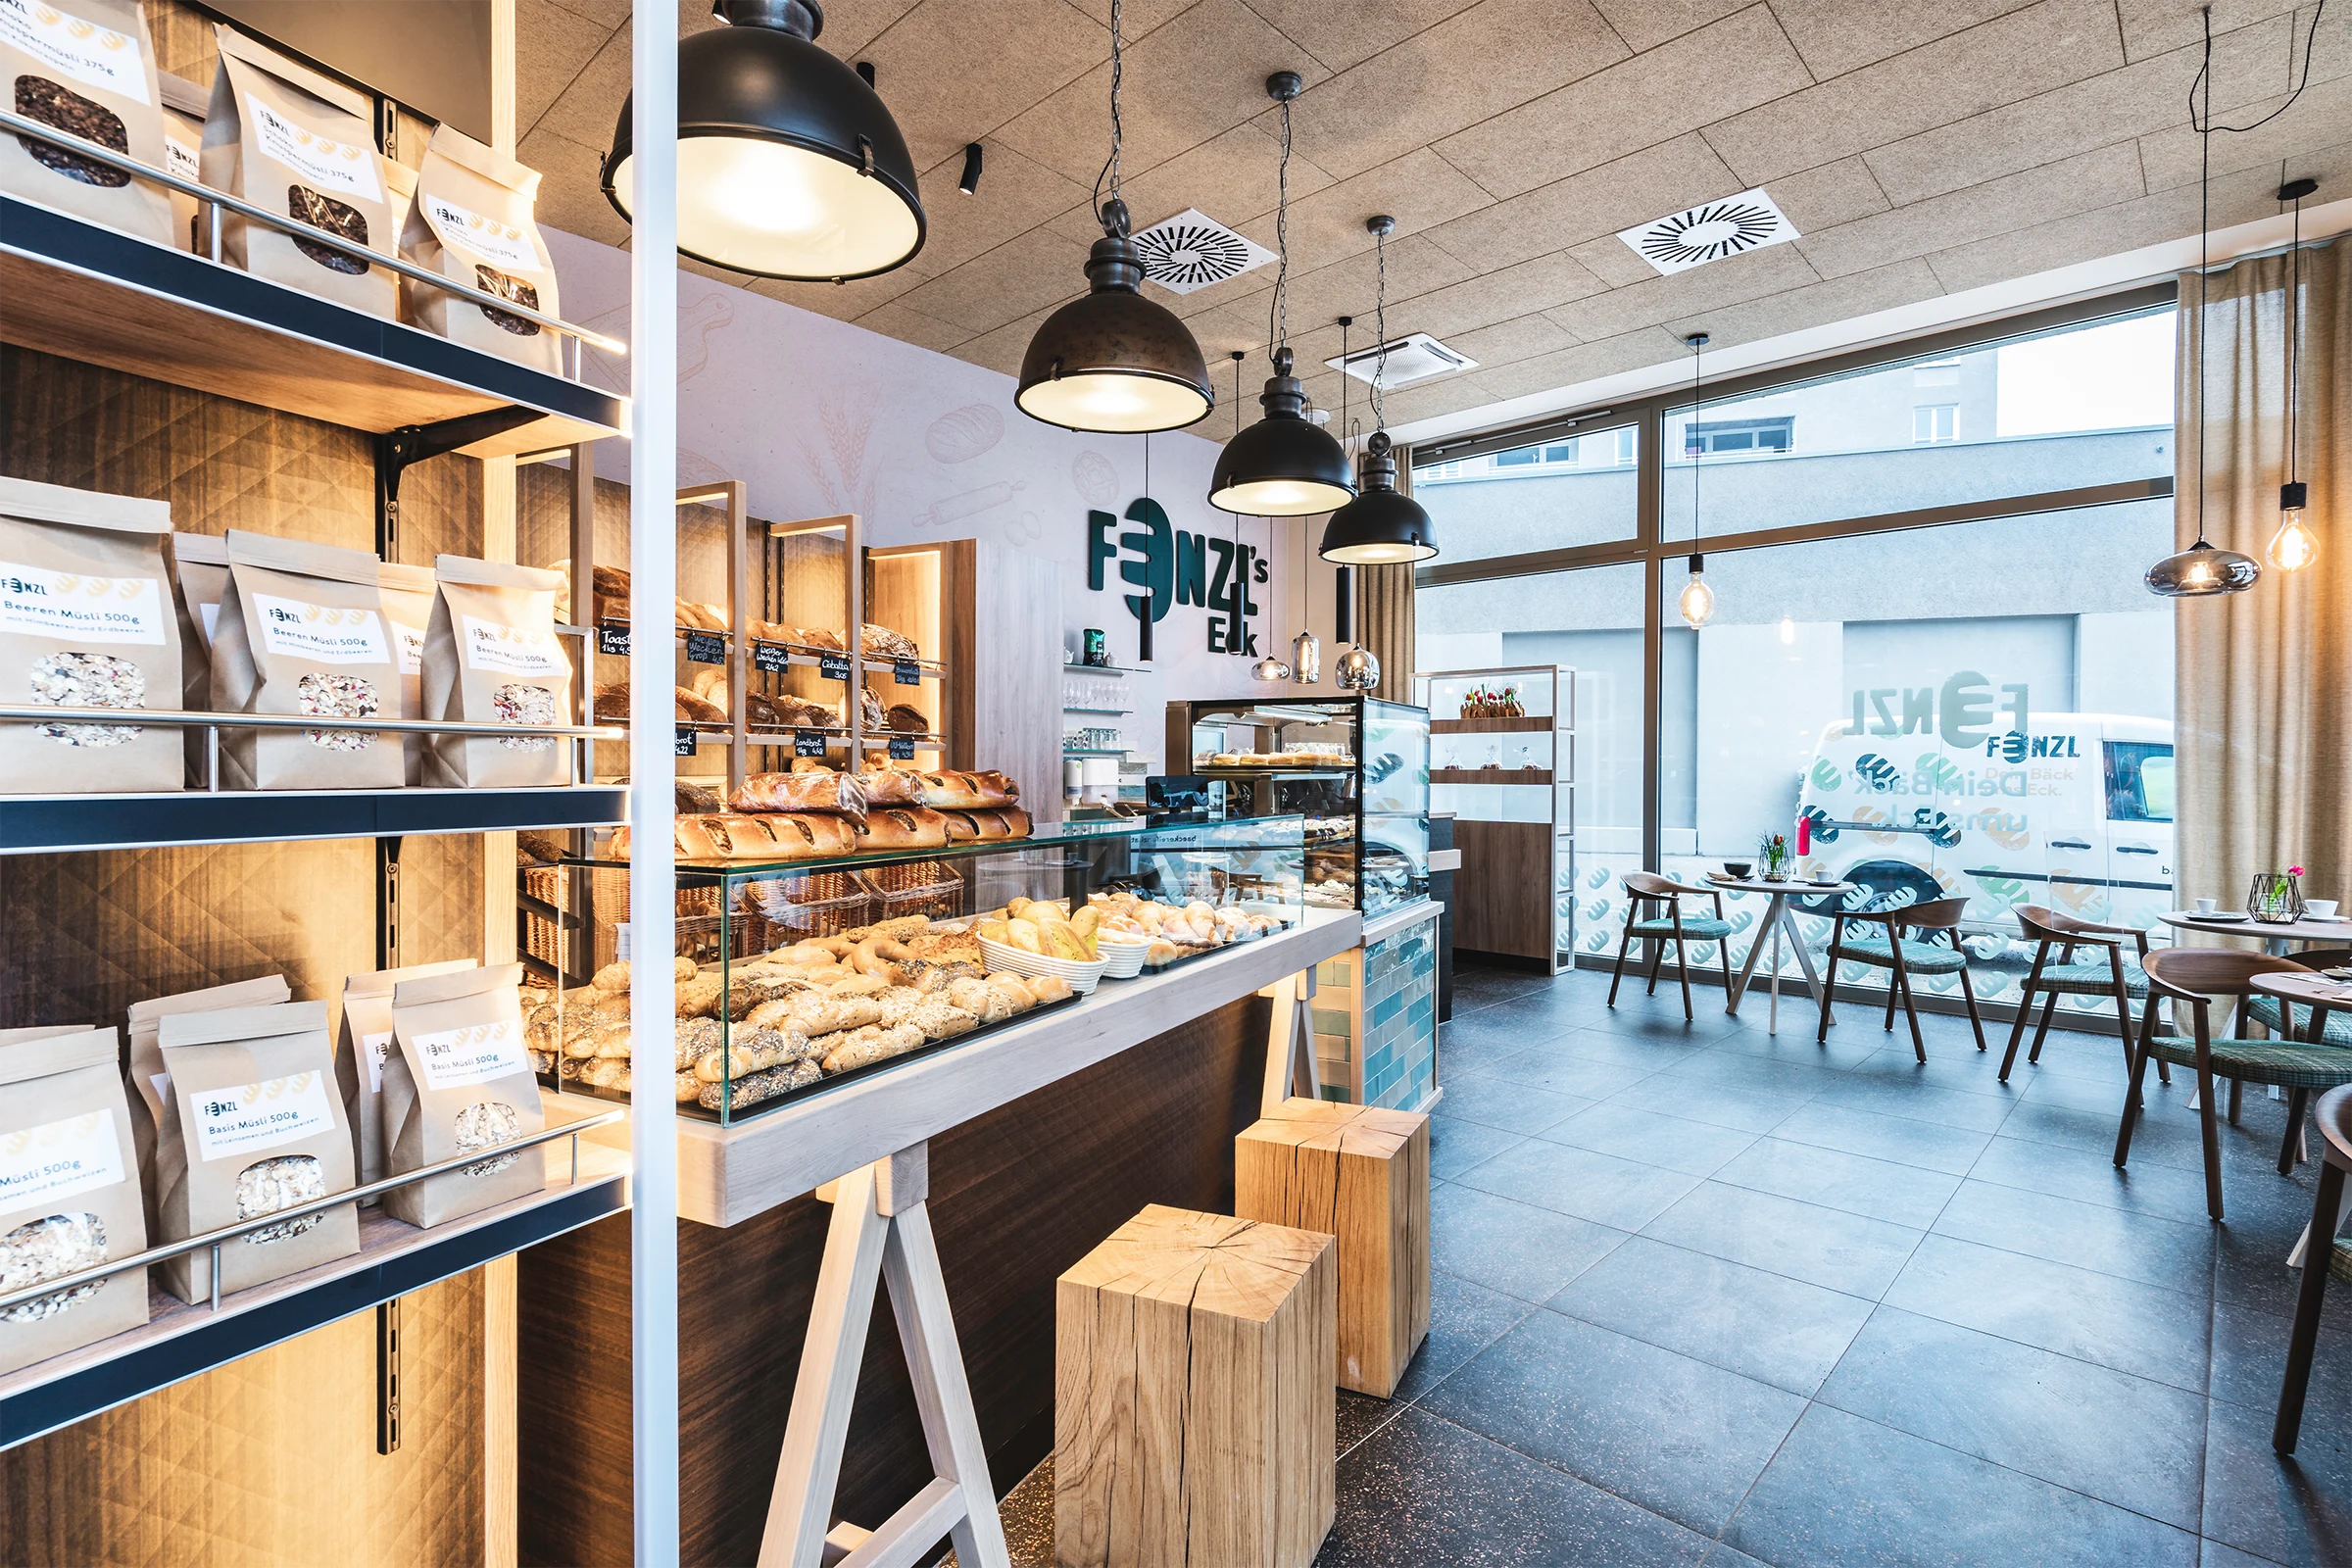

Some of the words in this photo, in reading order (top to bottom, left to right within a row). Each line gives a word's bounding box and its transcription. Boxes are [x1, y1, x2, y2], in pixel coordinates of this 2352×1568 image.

[83, 58, 115, 76] 375g
[260, 110, 291, 137] FENZL
[330, 170, 354, 182] 375g
[436, 208, 465, 226] FENZL
[498, 249, 519, 260] 375g
[1, 577, 48, 596] FENZL
[4, 601, 56, 615] Beeren
[61, 610, 100, 621] Müsli
[105, 612, 140, 625] 500g
[269, 608, 301, 623] FENZL
[272, 627, 308, 641] Beeren
[311, 635, 338, 646] Müsli
[340, 638, 368, 647] 500g
[403, 634, 424, 648] FENZ
[472, 628, 497, 643] FENZL
[475, 645, 503, 657] Beeren
[504, 652, 524, 662] Müsli
[525, 655, 548, 663] 500g
[689, 642, 724, 655] Wecken
[1986, 730, 2081, 763] FENZL
[426, 1044, 452, 1056] FENZL
[452, 1059, 474, 1068] Müsli
[475, 1054, 499, 1064] 500g
[204, 1102, 238, 1116] FENZL
[209, 1123, 235, 1135] Basis
[238, 1117, 268, 1129] Müsli
[270, 1111, 299, 1124] 500g
[275, 1117, 319, 1134] Buchweizen
[43, 1159, 81, 1176] 500g
[51, 1167, 107, 1187] Buchweizen
